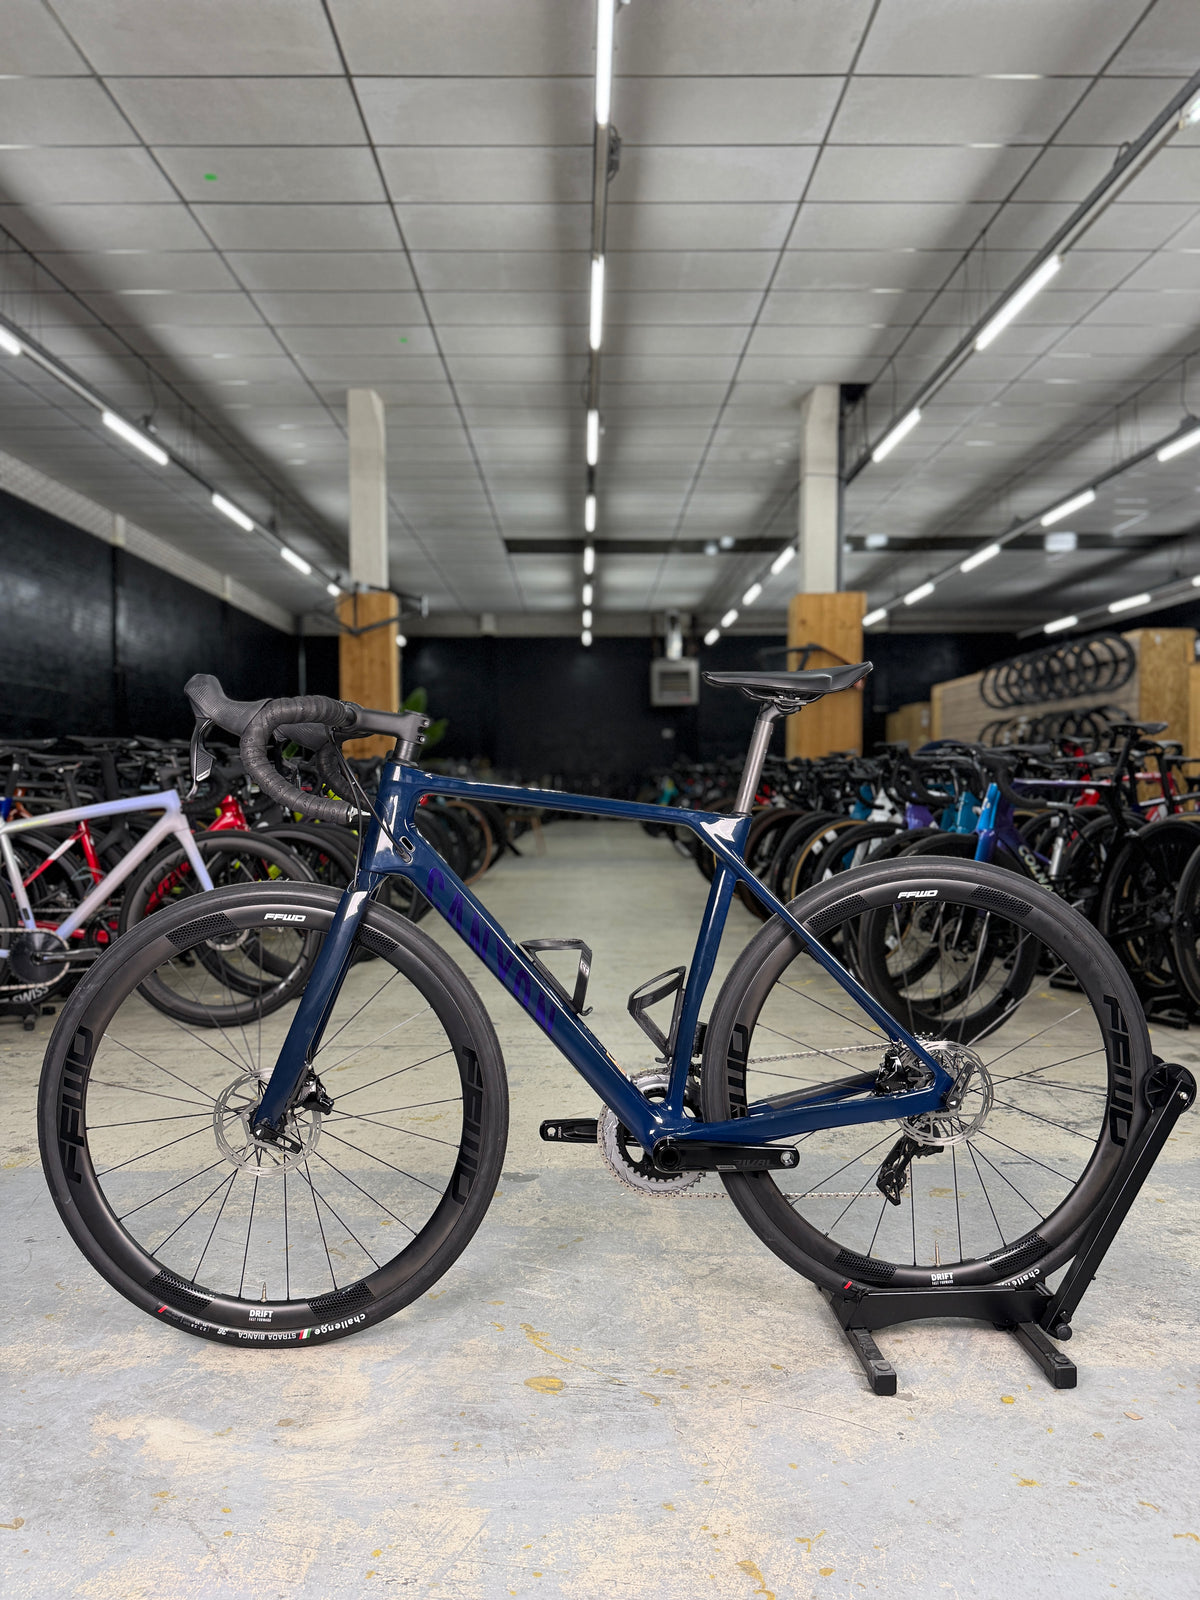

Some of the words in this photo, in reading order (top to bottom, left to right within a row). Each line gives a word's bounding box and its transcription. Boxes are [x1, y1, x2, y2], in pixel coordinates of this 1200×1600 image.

[897, 889, 938, 899] FFWD
[263, 912, 307, 922] FFWD
[426, 867, 556, 1034] CANYON
[1103, 994, 1133, 1147] FFWD
[60, 1025, 93, 1184] FFWD
[452, 1045, 484, 1205] FFWD
[931, 1272, 954, 1281] DRIFT
[1000, 1268, 1040, 1287] challe
[249, 1309, 274, 1318] DRIFT
[314, 1313, 366, 1335] challenge
[238, 1331, 265, 1341] BIANCA
[268, 1332, 297, 1341] STRADA
